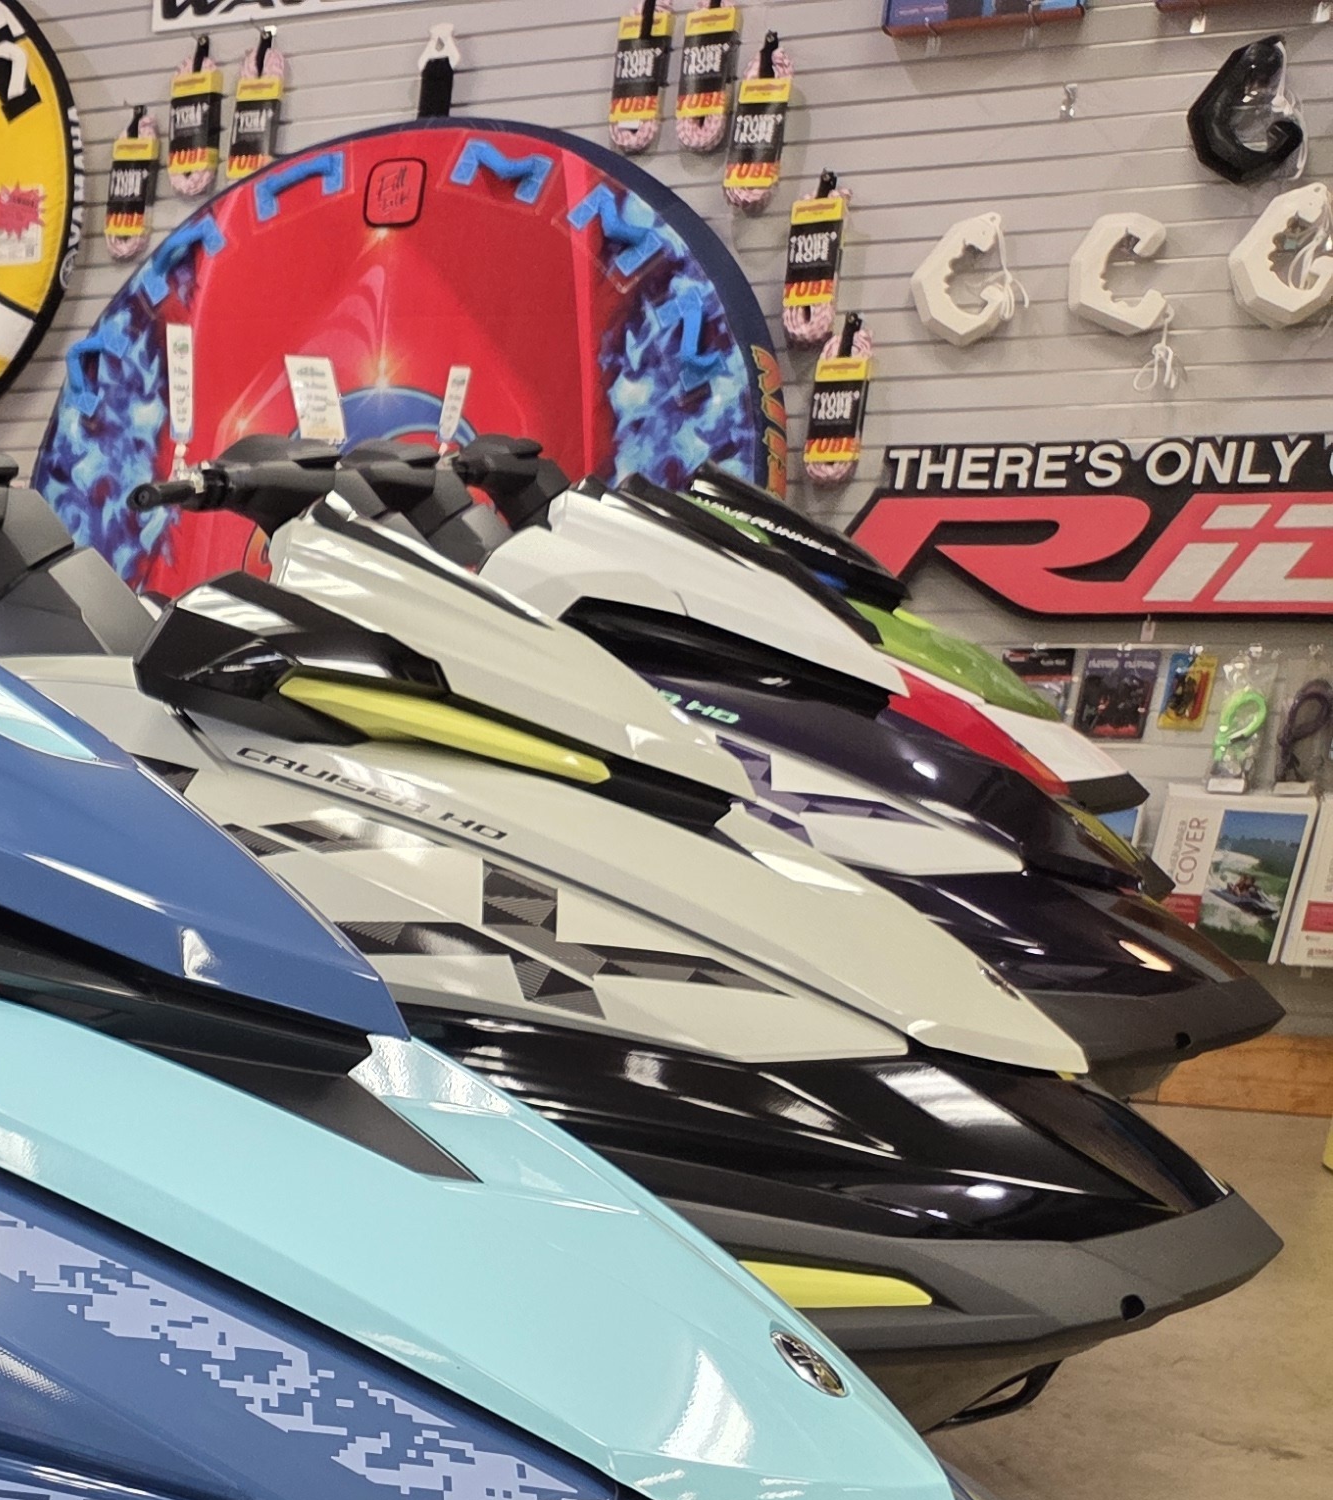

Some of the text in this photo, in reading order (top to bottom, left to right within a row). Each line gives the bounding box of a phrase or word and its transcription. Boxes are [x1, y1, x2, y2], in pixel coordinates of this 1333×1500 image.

[611, 96, 658, 113] TUBE
[677, 92, 725, 110] TUBE
[726, 163, 779, 179] TUBE
[785, 280, 833, 298] TUBE
[808, 438, 859, 453] TUBE
[889, 440, 1312, 491] THERE'S ONLY
[684, 699, 740, 724] HO
[236, 746, 508, 840] CRUISER HO
[1175, 817, 1209, 885] COVER
